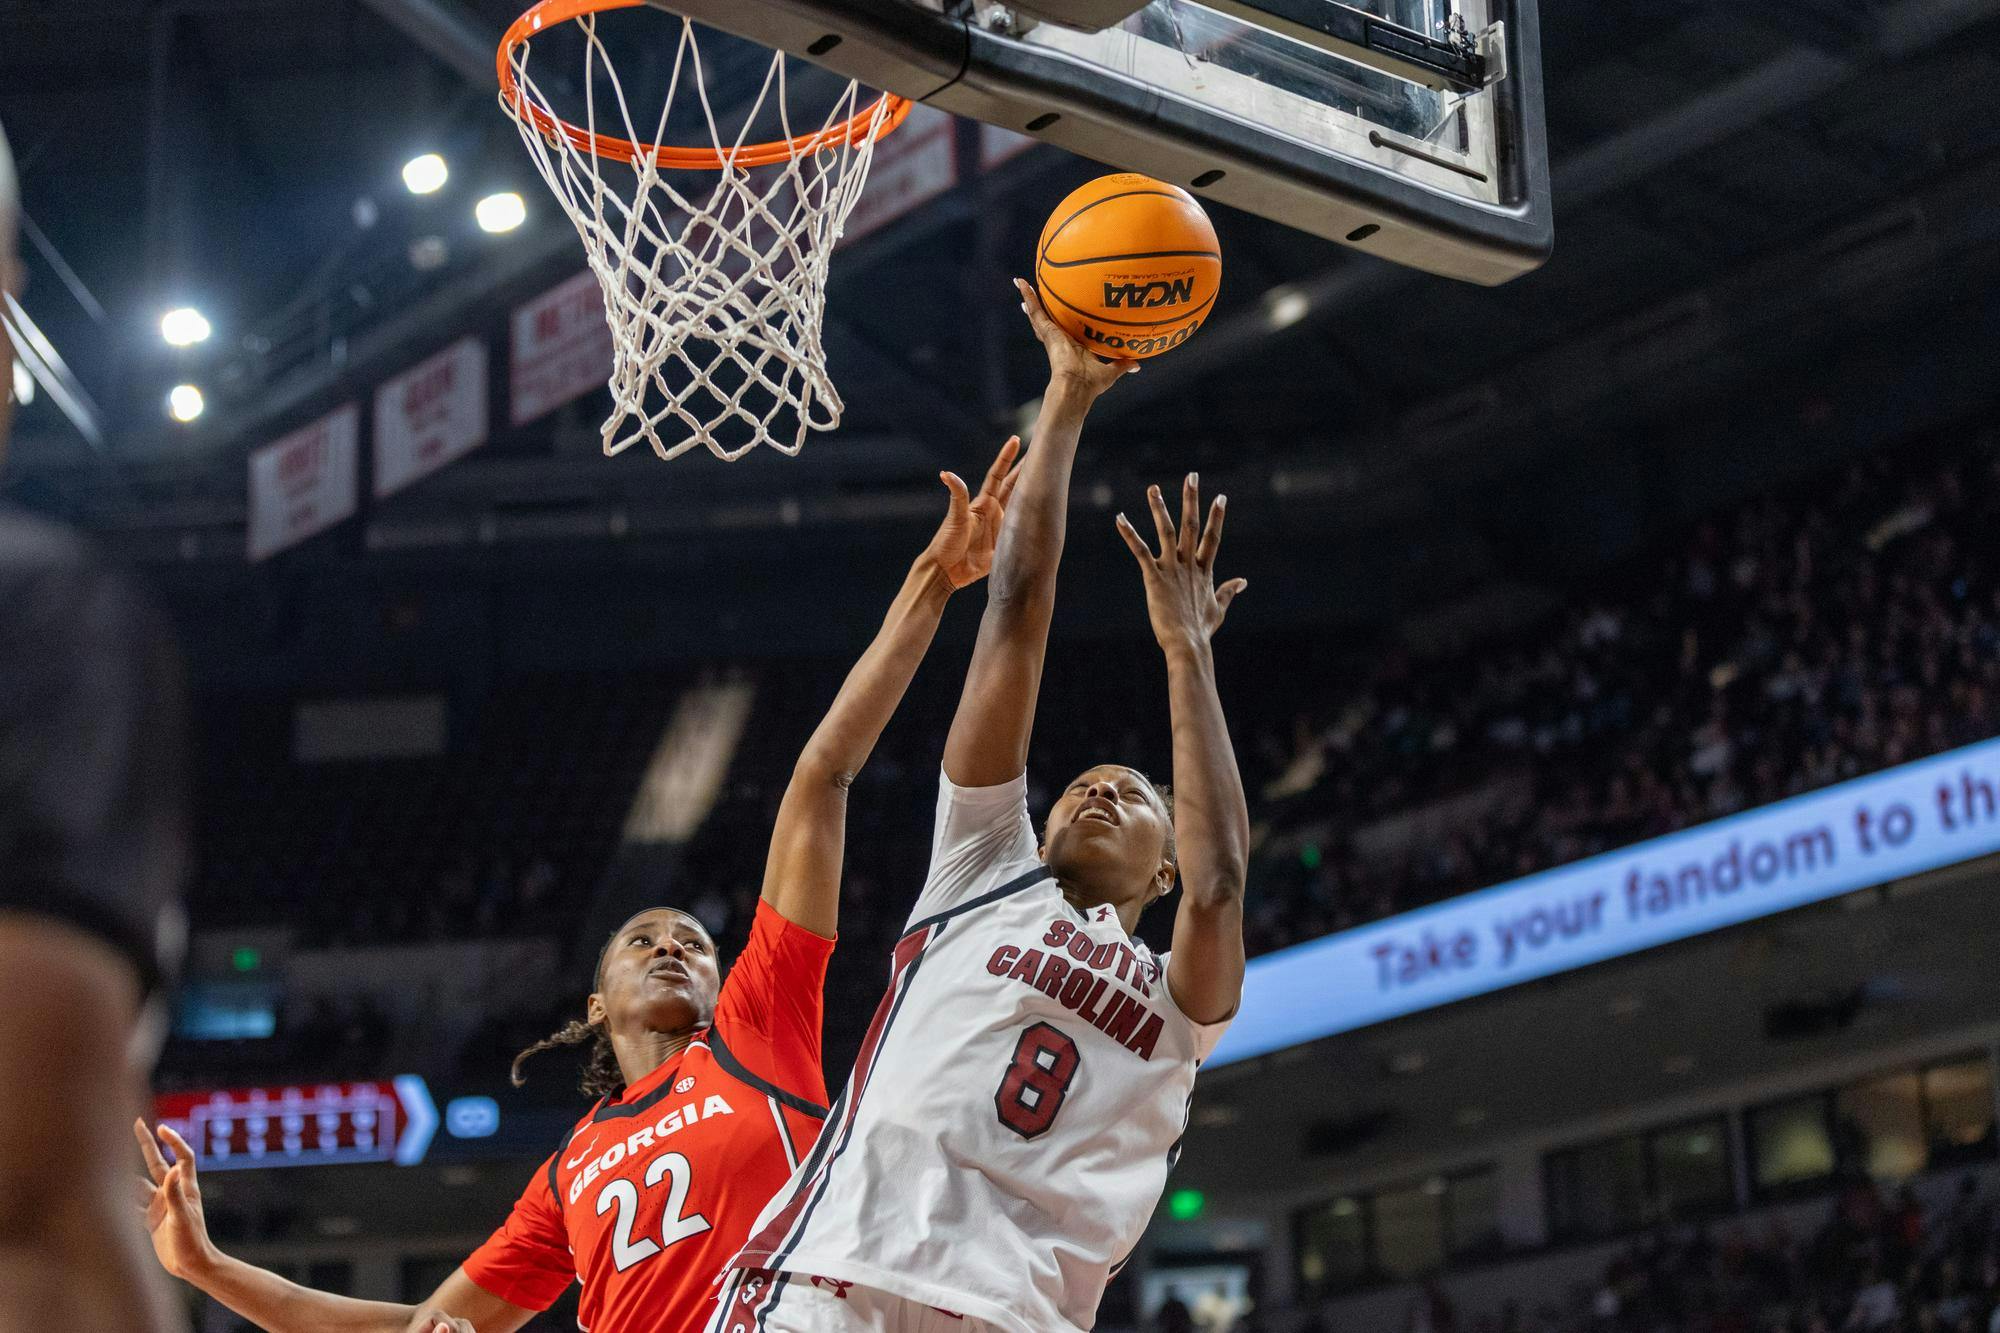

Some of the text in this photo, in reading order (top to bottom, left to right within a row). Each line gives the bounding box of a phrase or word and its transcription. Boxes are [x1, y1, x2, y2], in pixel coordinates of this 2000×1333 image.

[1083, 319, 1199, 355] Wilson
[1103, 276, 1195, 309] NCAA
[1371, 769, 2000, 993] Take your fandom to th
[985, 944, 1165, 1062] CAROLINA
[674, 1076, 696, 1094] SEC
[994, 1020, 1081, 1141] 8
[569, 1094, 735, 1206] GEORGIA
[595, 1151, 712, 1274] 22
